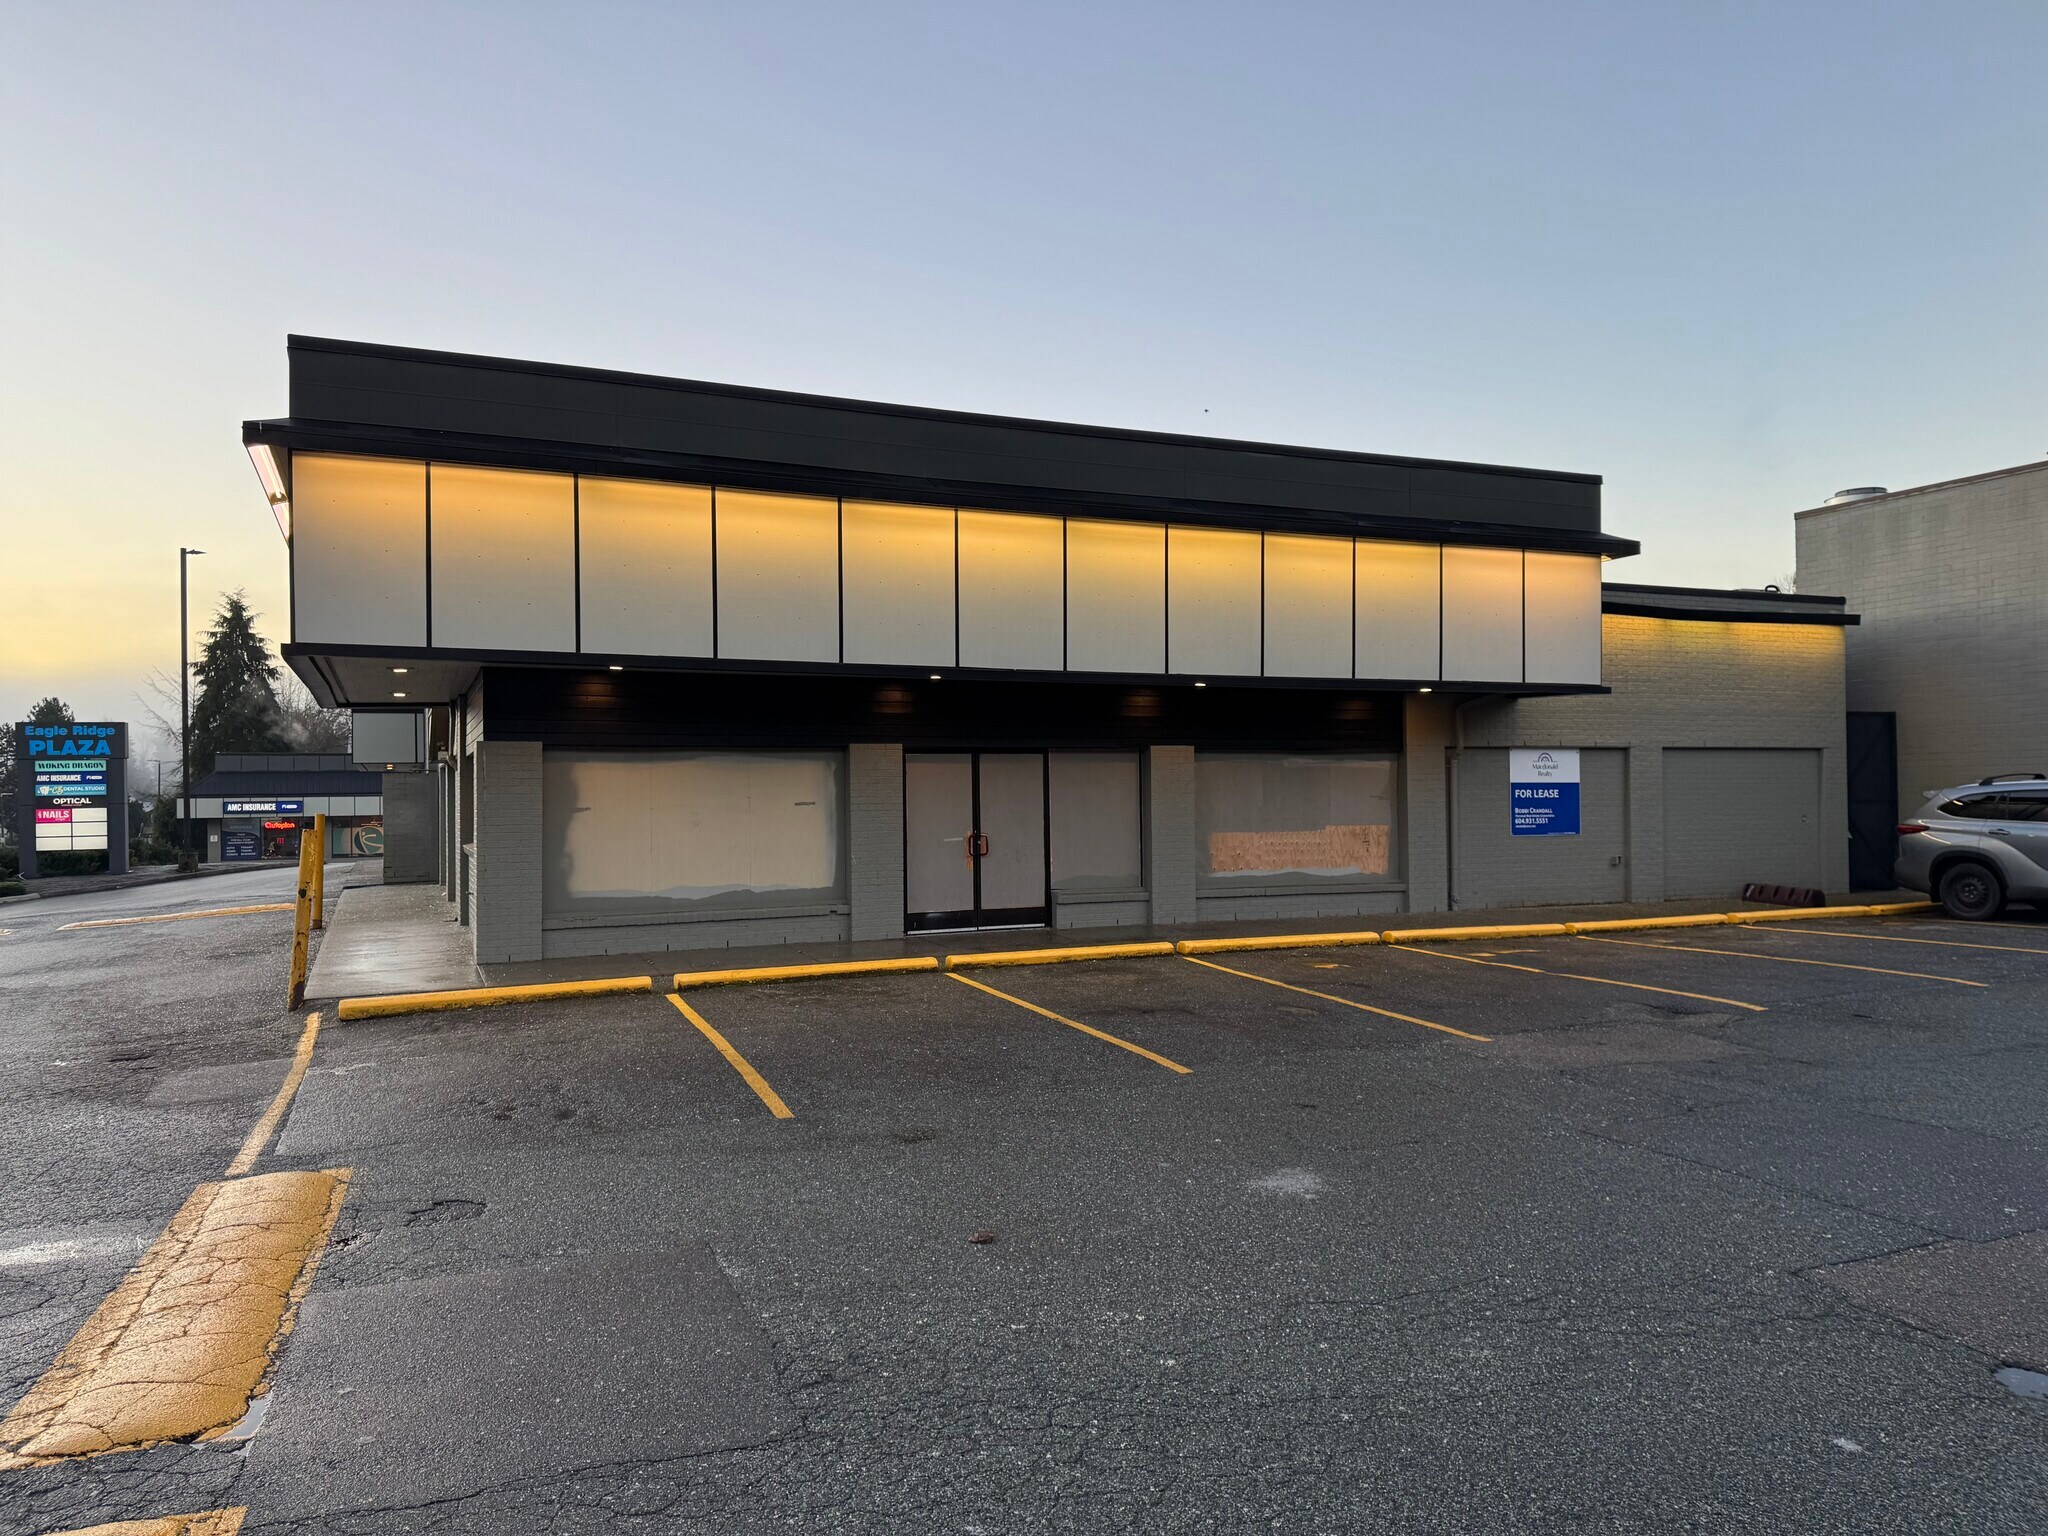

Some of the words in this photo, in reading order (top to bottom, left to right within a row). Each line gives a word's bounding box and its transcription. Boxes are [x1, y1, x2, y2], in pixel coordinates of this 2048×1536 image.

[25, 725, 67, 737] Eagle
[73, 725, 115, 737] Ridge
[29, 740, 111, 755] PLAZA
[1515, 790, 1532, 798] FOR
[1534, 790, 1559, 798] LEASE
[227, 803, 241, 811] AMC
[243, 803, 276, 811] INSURANCE
[43, 810, 70, 818] NAILS
